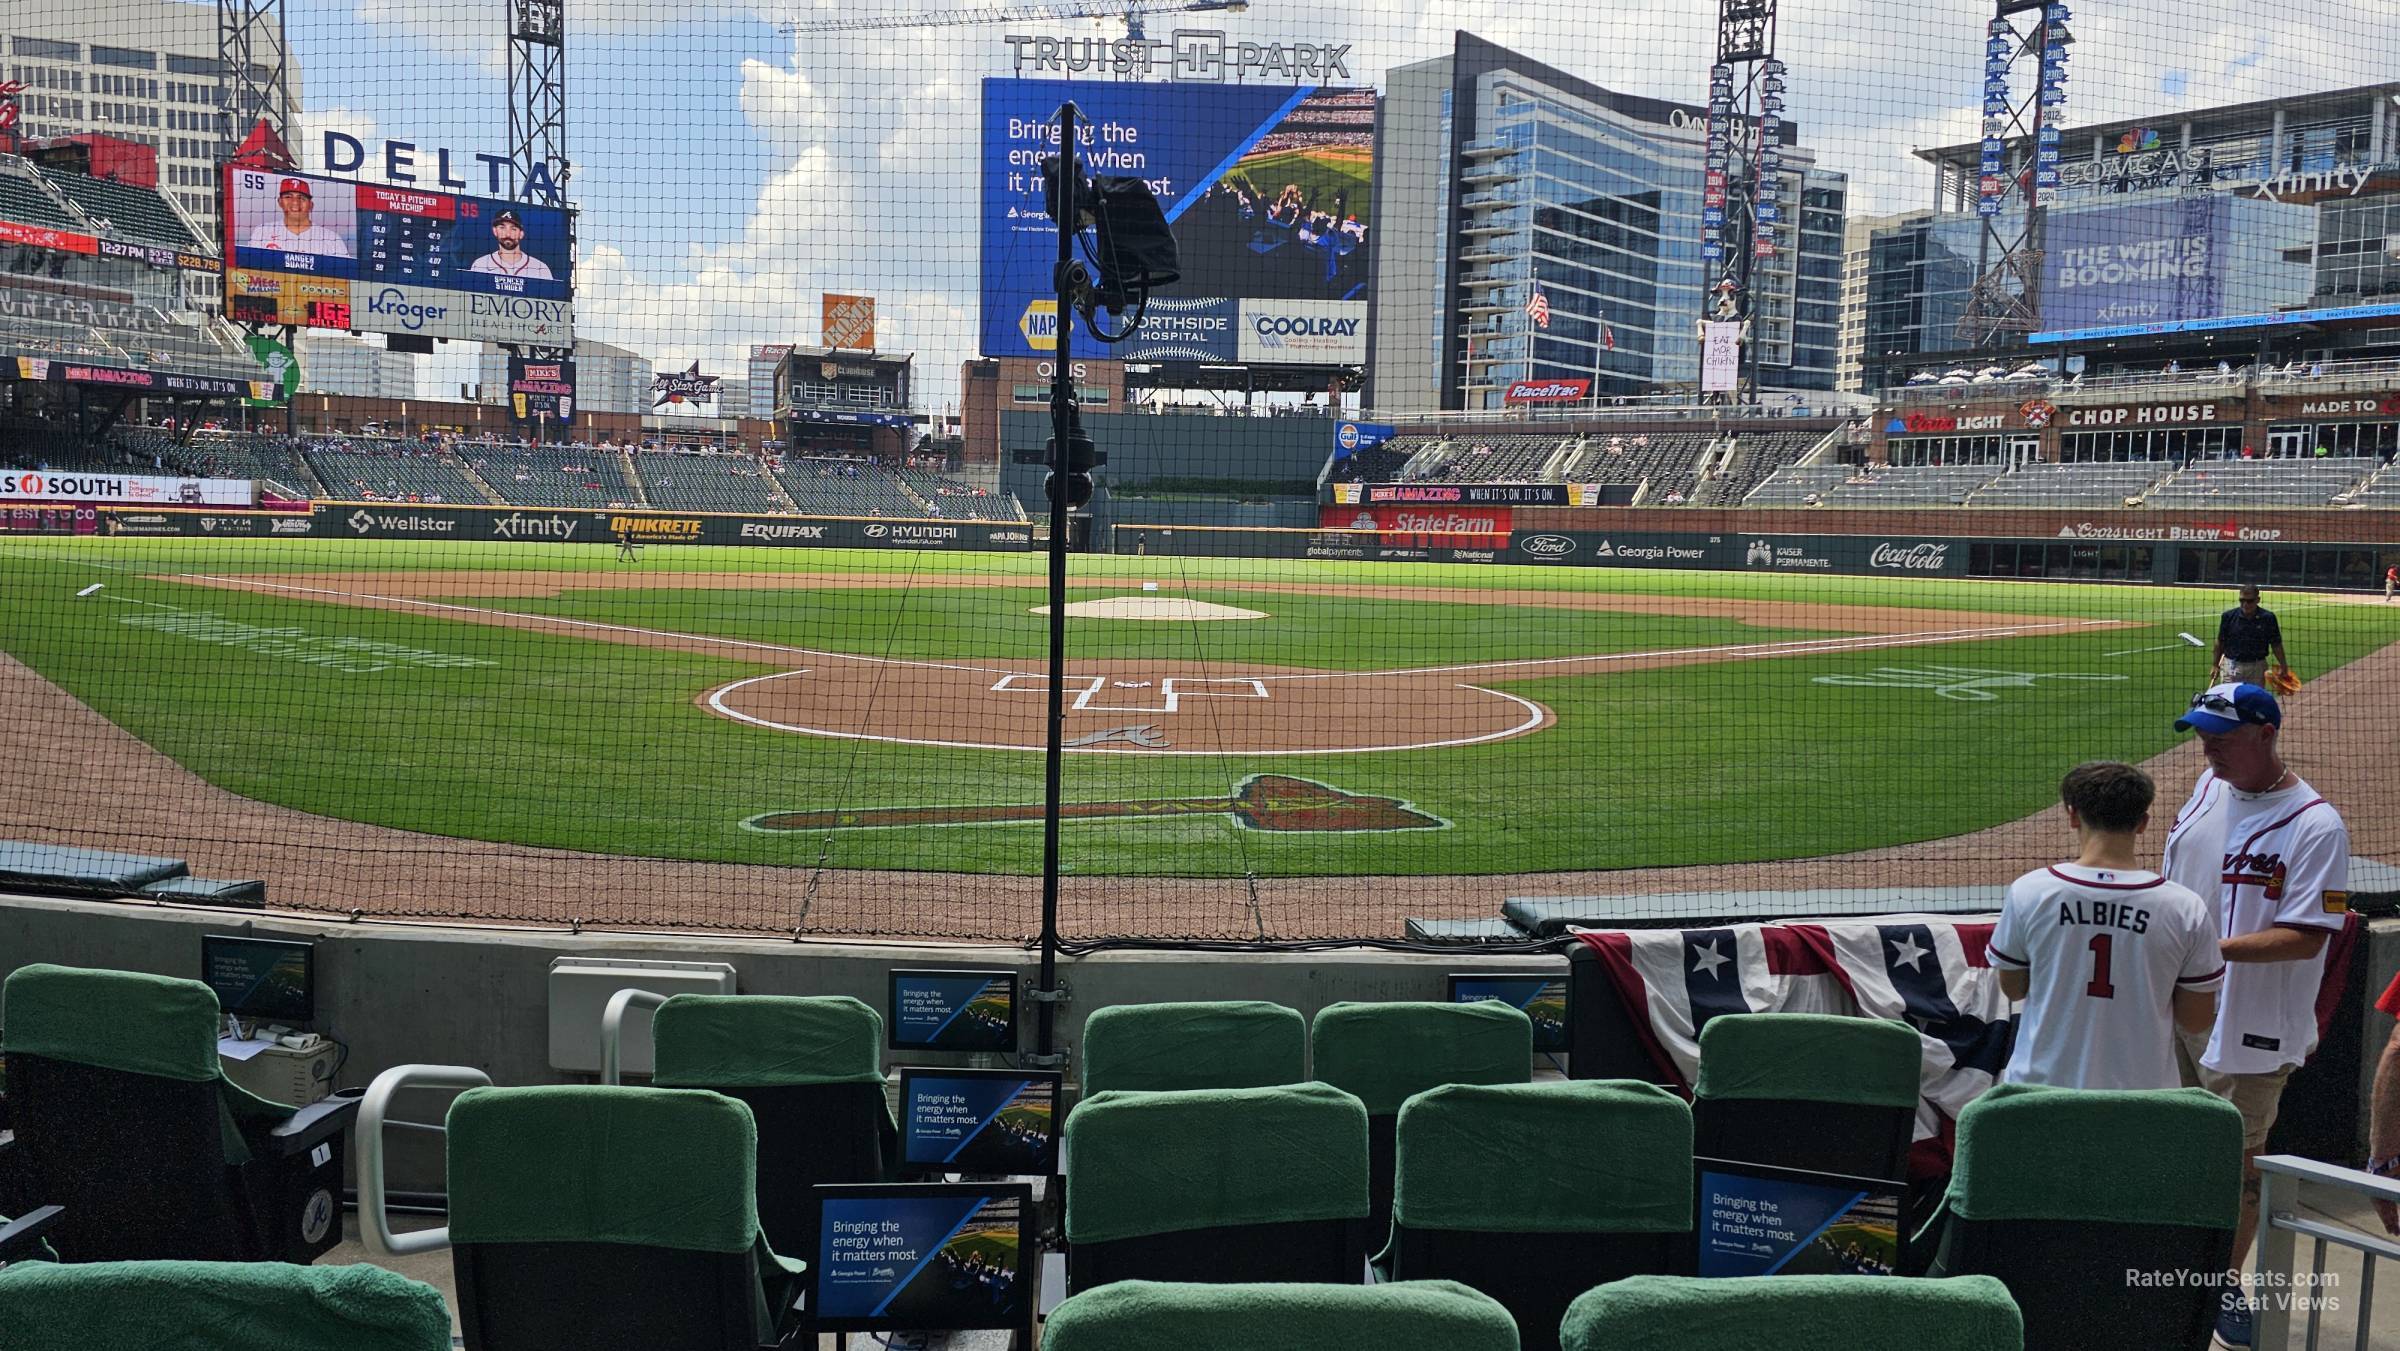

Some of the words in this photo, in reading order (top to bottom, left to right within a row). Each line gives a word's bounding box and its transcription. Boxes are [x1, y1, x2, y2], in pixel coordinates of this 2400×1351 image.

[1005, 35, 1161, 73] TRUIST
[1238, 42, 1352, 78] PARK
[1669, 109, 1708, 131] OMN
[1009, 118, 1095, 145] Bringng
[1102, 122, 1137, 143] the
[1087, 147, 1145, 169] when
[325, 131, 562, 207] DELTA
[2059, 150, 2214, 185] COMCAST
[1009, 171, 1023, 191] it
[2039, 171, 2055, 182] 2022
[2253, 163, 2374, 201] xfinity
[376, 191, 407, 202] TODAY'S
[408, 194, 437, 206] PITCHER
[389, 202, 424, 212] MATCHUP
[101, 241, 127, 256] 12:27
[129, 245, 144, 259] PM
[2062, 247, 2110, 267] THE
[2182, 236, 2207, 256] IS
[2059, 260, 2204, 288] BOOMING
[369, 288, 447, 330] Kroger
[471, 294, 566, 322] EMORY
[828, 301, 850, 320] THE
[2097, 301, 2159, 320] xfinity
[471, 318, 563, 335] HEALTHCARE
[823, 298, 874, 347] HOME
[1028, 314, 1057, 334] NAP
[1122, 316, 1227, 330] NORTHSIDE
[1256, 317, 1361, 337] COOLRAY
[843, 316, 874, 347] DEPOT
[1141, 331, 1208, 342] HOSPITAL
[92, 369, 152, 385] AMAZING
[529, 369, 557, 377] MIKE'S
[838, 366, 876, 377] CLUBHOUSE
[167, 377, 184, 388] WHEN
[186, 378, 199, 389] IT'S
[213, 381, 226, 392] IT'S
[512, 380, 572, 394] AMAZING
[669, 379, 692, 391] Star
[694, 380, 724, 394] Game
[1511, 384, 1580, 398] RaceTrac
[2069, 409, 2129, 426] CHOP
[2137, 404, 2215, 423] HOUSE
[2303, 401, 2350, 415] MADE
[2354, 400, 2377, 412] TO
[1956, 416, 2005, 430] LIGHT
[49, 477, 122, 496] SOUTH
[1470, 488, 1490, 500] WHEN
[1492, 488, 1507, 500] IT'S
[1524, 489, 1539, 501] IT'S
[1397, 488, 1461, 502] AMAZING
[378, 514, 455, 532] Wellstar
[493, 513, 578, 539] xfinity
[610, 517, 702, 533] QUIKRETE
[740, 523, 826, 541] EQUIFAX
[892, 526, 957, 538] HYUNDAI
[2077, 523, 2121, 539] Coors
[2122, 528, 2164, 539] LIGHT
[2169, 527, 2220, 540] BELOW
[2239, 527, 2281, 540] CHOP
[1530, 538, 1565, 553] Ford
[1617, 545, 1663, 560] Georgia
[1667, 546, 1704, 559] Power
[1776, 548, 1803, 556] KAISER
[1462, 551, 1494, 559] National
[2059, 901, 2150, 935] ALBIES
[2087, 934, 2114, 999] 1
[903, 990, 928, 999] Bringing
[930, 990, 941, 998] the
[903, 999, 925, 1007] energy
[917, 1094, 950, 1105] Bringing
[952, 1095, 965, 1103] the
[917, 1105, 943, 1114] energy
[946, 1105, 968, 1113] when
[916, 1115, 922, 1123] it
[924, 1115, 955, 1123] matters
[957, 1116, 979, 1124] most.
[1713, 1193, 1756, 1211] Bringing
[1760, 1200, 1778, 1212] the
[1713, 1210, 1749, 1223] energy
[1752, 1214, 1782, 1226] when
[833, 1221, 878, 1234] Bringing
[881, 1221, 899, 1232] the
[1712, 1222, 1720, 1232] it
[1723, 1223, 1763, 1237] matters
[1766, 1230, 1797, 1242] most.
[833, 1236, 870, 1248] energy
[873, 1235, 903, 1246] when
[832, 1250, 840, 1261] it
[843, 1250, 885, 1261] matters
[889, 1250, 918, 1261] most.
